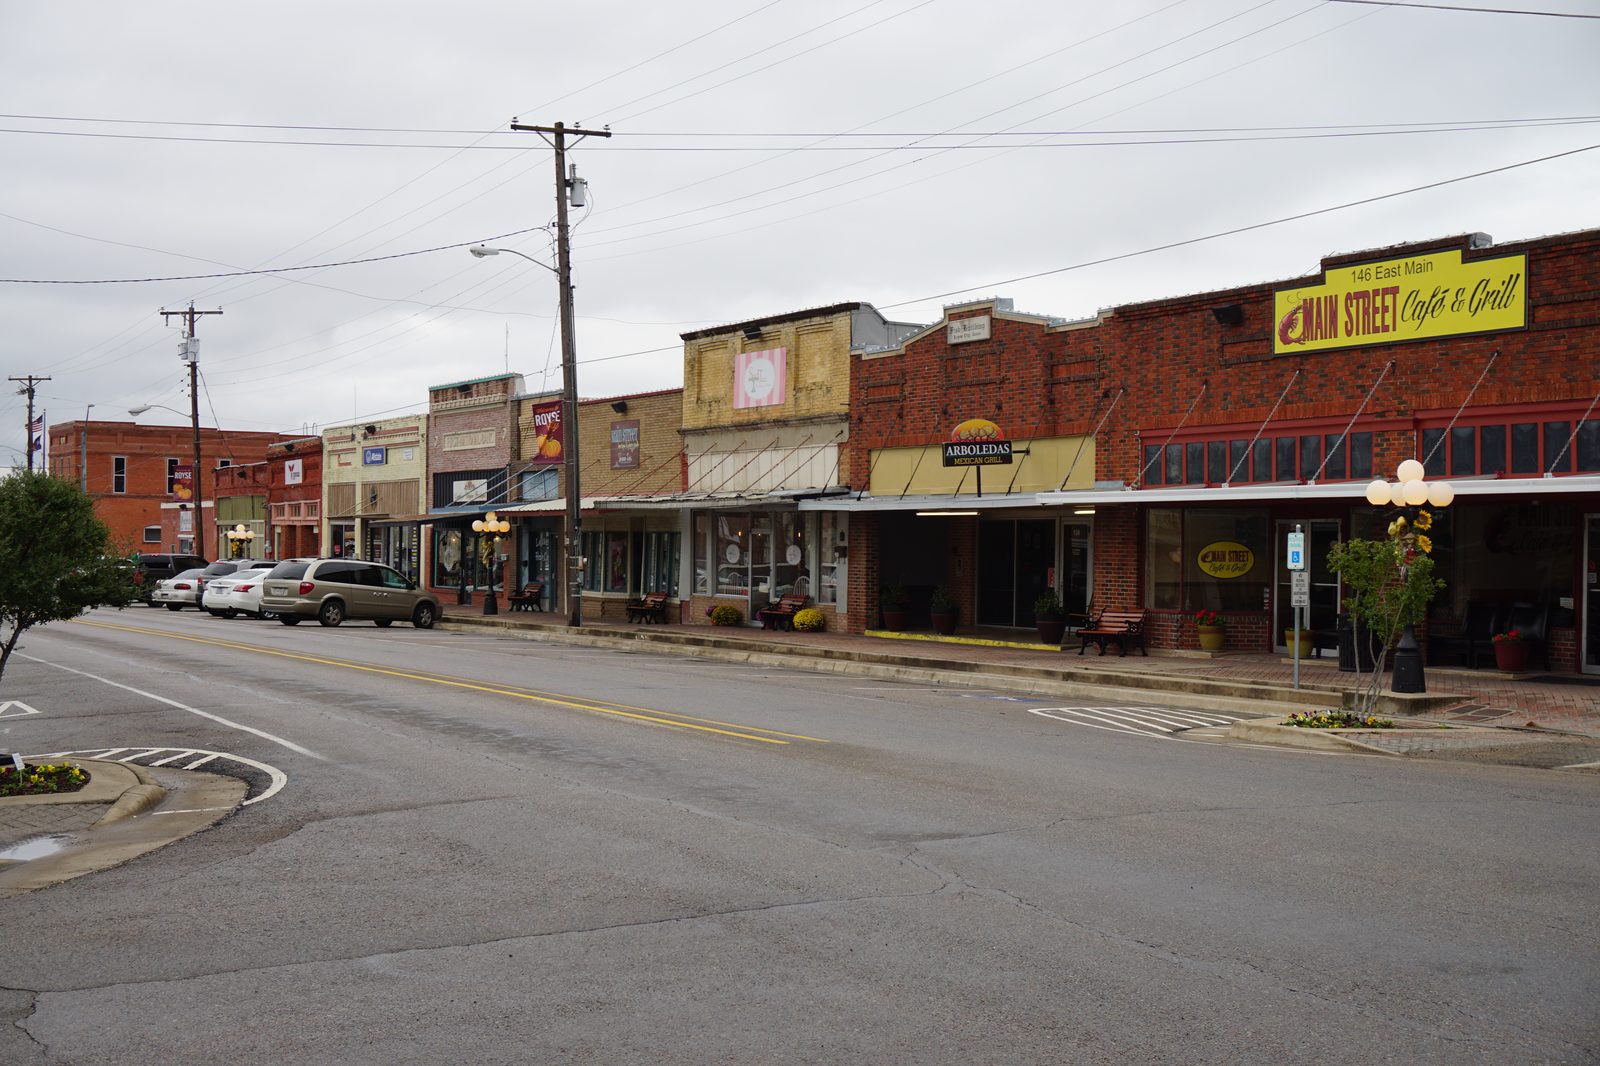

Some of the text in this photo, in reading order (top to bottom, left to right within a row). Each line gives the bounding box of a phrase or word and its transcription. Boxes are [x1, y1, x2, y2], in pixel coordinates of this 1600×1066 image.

[1351, 260, 1433, 283] 146 East Main
[1302, 273, 1520, 342] MAIN STREET Café & Grill
[946, 443, 1010, 456] ARBOLEDAS
[954, 456, 1003, 465] MEXICAN GRILL
[174, 471, 192, 480] ROYSE
[1228, 550, 1249, 562] STREET
